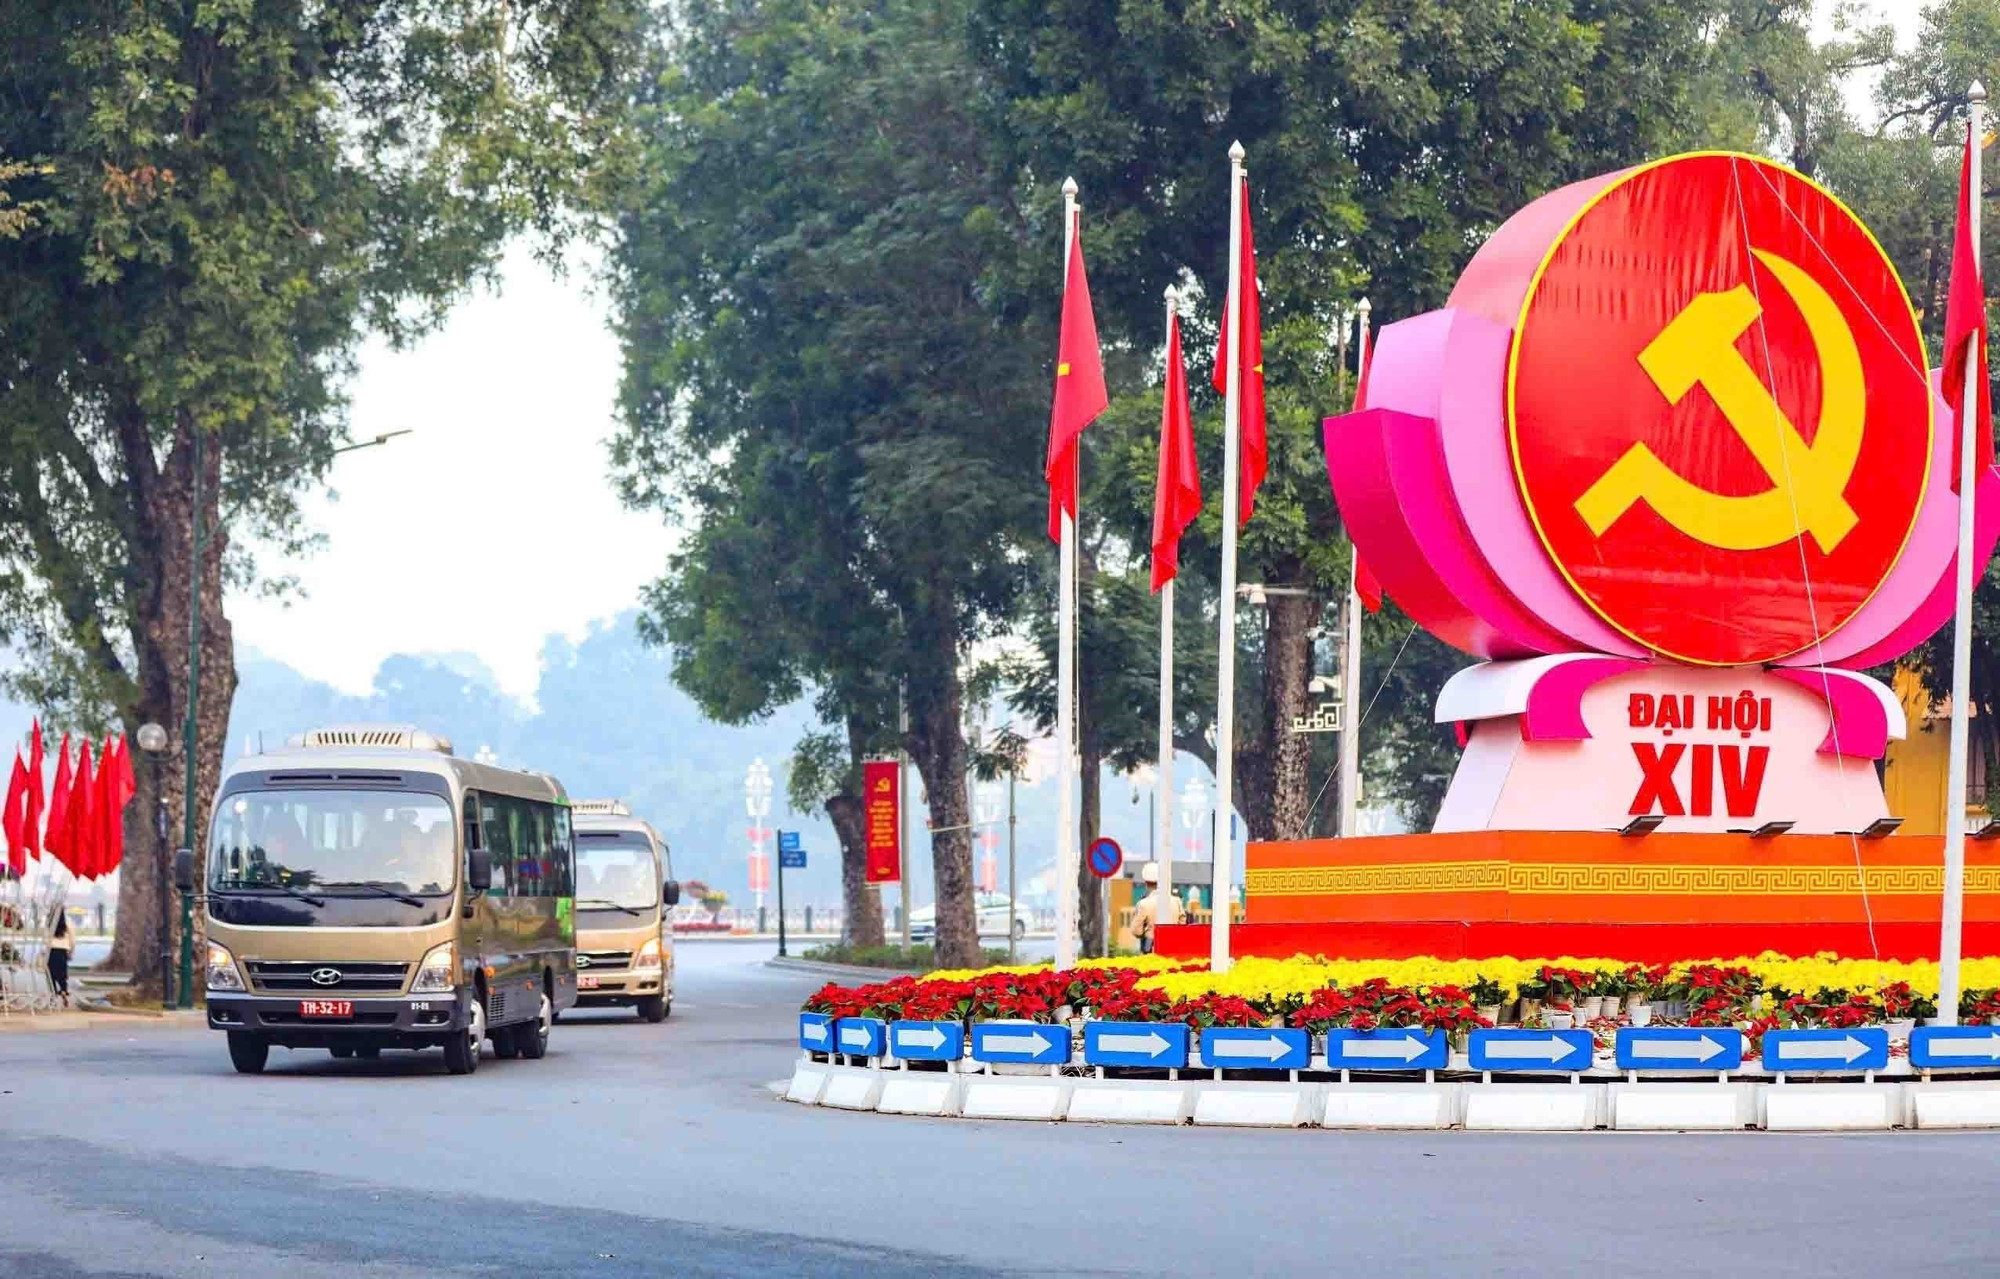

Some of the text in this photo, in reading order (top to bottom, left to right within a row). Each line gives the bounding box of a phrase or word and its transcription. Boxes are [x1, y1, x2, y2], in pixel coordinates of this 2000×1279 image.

[1628, 690, 1772, 738] ĐẠI HỘI
[1628, 742, 1770, 817] XIV
[301, 1001, 351, 1015] TH-32-17
